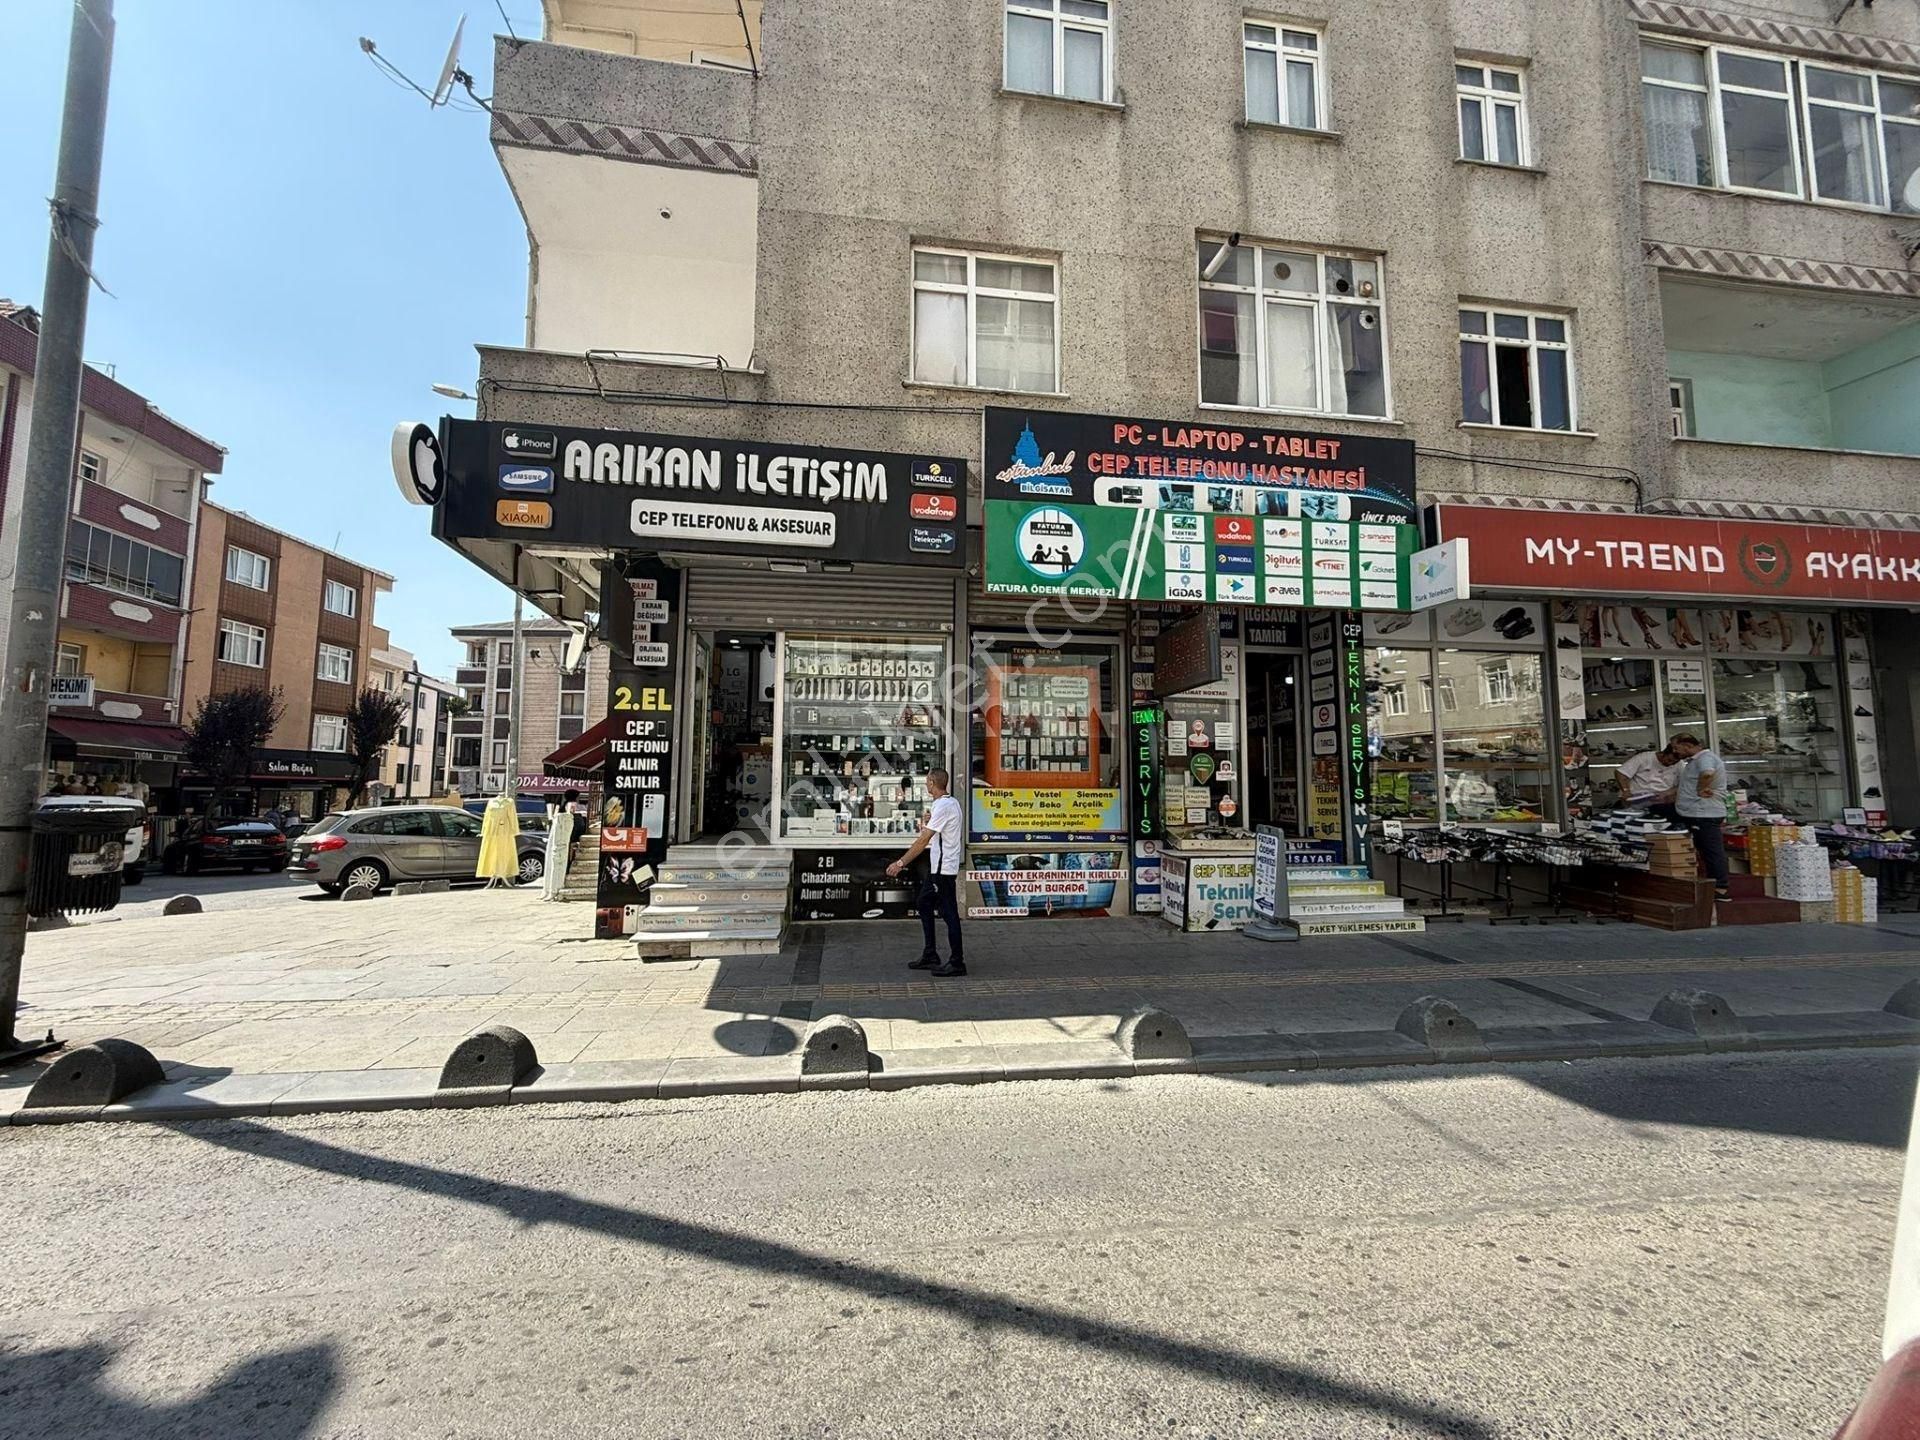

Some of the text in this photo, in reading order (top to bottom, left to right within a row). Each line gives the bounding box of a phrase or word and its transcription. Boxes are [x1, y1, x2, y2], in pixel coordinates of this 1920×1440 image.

[521, 438, 551, 449] iPhone
[1114, 424, 1142, 445] PC
[1162, 427, 1245, 452] LAPTOP
[1263, 435, 1341, 460] TABLET
[508, 471, 543, 481] SAMSUNG
[563, 439, 889, 504] ARIKAN İLETİŞİM
[1087, 452, 1366, 491] CEP TELEFONU HASTANESİ
[915, 474, 954, 484] TURKCELL
[1021, 483, 1073, 495] BİLGİSAYAR
[502, 512, 543, 524] XIAOMI
[914, 507, 954, 517] vodafone
[638, 510, 832, 537] CEP TELEFONU & AKSESUAR
[1386, 514, 1407, 524] 1996
[914, 528, 929, 536] Türk
[1037, 523, 1066, 531] FATURA
[914, 535, 943, 544] Telekom
[1218, 533, 1252, 541] vodafone
[1526, 538, 1920, 582] MY-TREND AYAKK
[1322, 562, 1345, 571] TTNET
[987, 584, 1116, 597] FATURA ÖDEME MERKEZİ
[1278, 586, 1301, 595] avea
[1429, 587, 1454, 598] Telekom
[641, 602, 663, 610] EKRAN
[1249, 625, 1287, 643] TAMİRİ
[1343, 624, 1361, 636] CEP
[636, 655, 666, 663] AKSESUAR
[726, 668, 741, 676] LG
[1348, 639, 1360, 714] TEKNİK
[50, 678, 87, 693] HEKİMİ
[614, 687, 672, 711] 2.EL
[626, 721, 655, 736] CEP
[610, 740, 669, 753] TELEFONU
[619, 758, 658, 771] ALINIR
[1351, 724, 1365, 799] SERVİS
[616, 776, 660, 789] SATILIR
[1140, 728, 1152, 834] SERVİS
[984, 790, 1013, 798] Philips
[1315, 785, 1338, 793] TELEFON
[990, 801, 1103, 809] Lg Sony Beko Arçelik
[818, 857, 824, 868] 2
[968, 871, 1024, 880] TELEVİZYON
[1026, 871, 1086, 880] EKRANINIZMI
[1193, 864, 1216, 878] CEP
[801, 872, 850, 884] Cihazlarınız
[801, 888, 850, 901] Alınır Satılır
[1009, 882, 1042, 895] ÇÖZÜM
[1196, 884, 1254, 901] Teknik
[1213, 903, 1258, 919] Serv
[1309, 922, 1416, 933] PAKET YÜKLEMESİ YAPILIR
